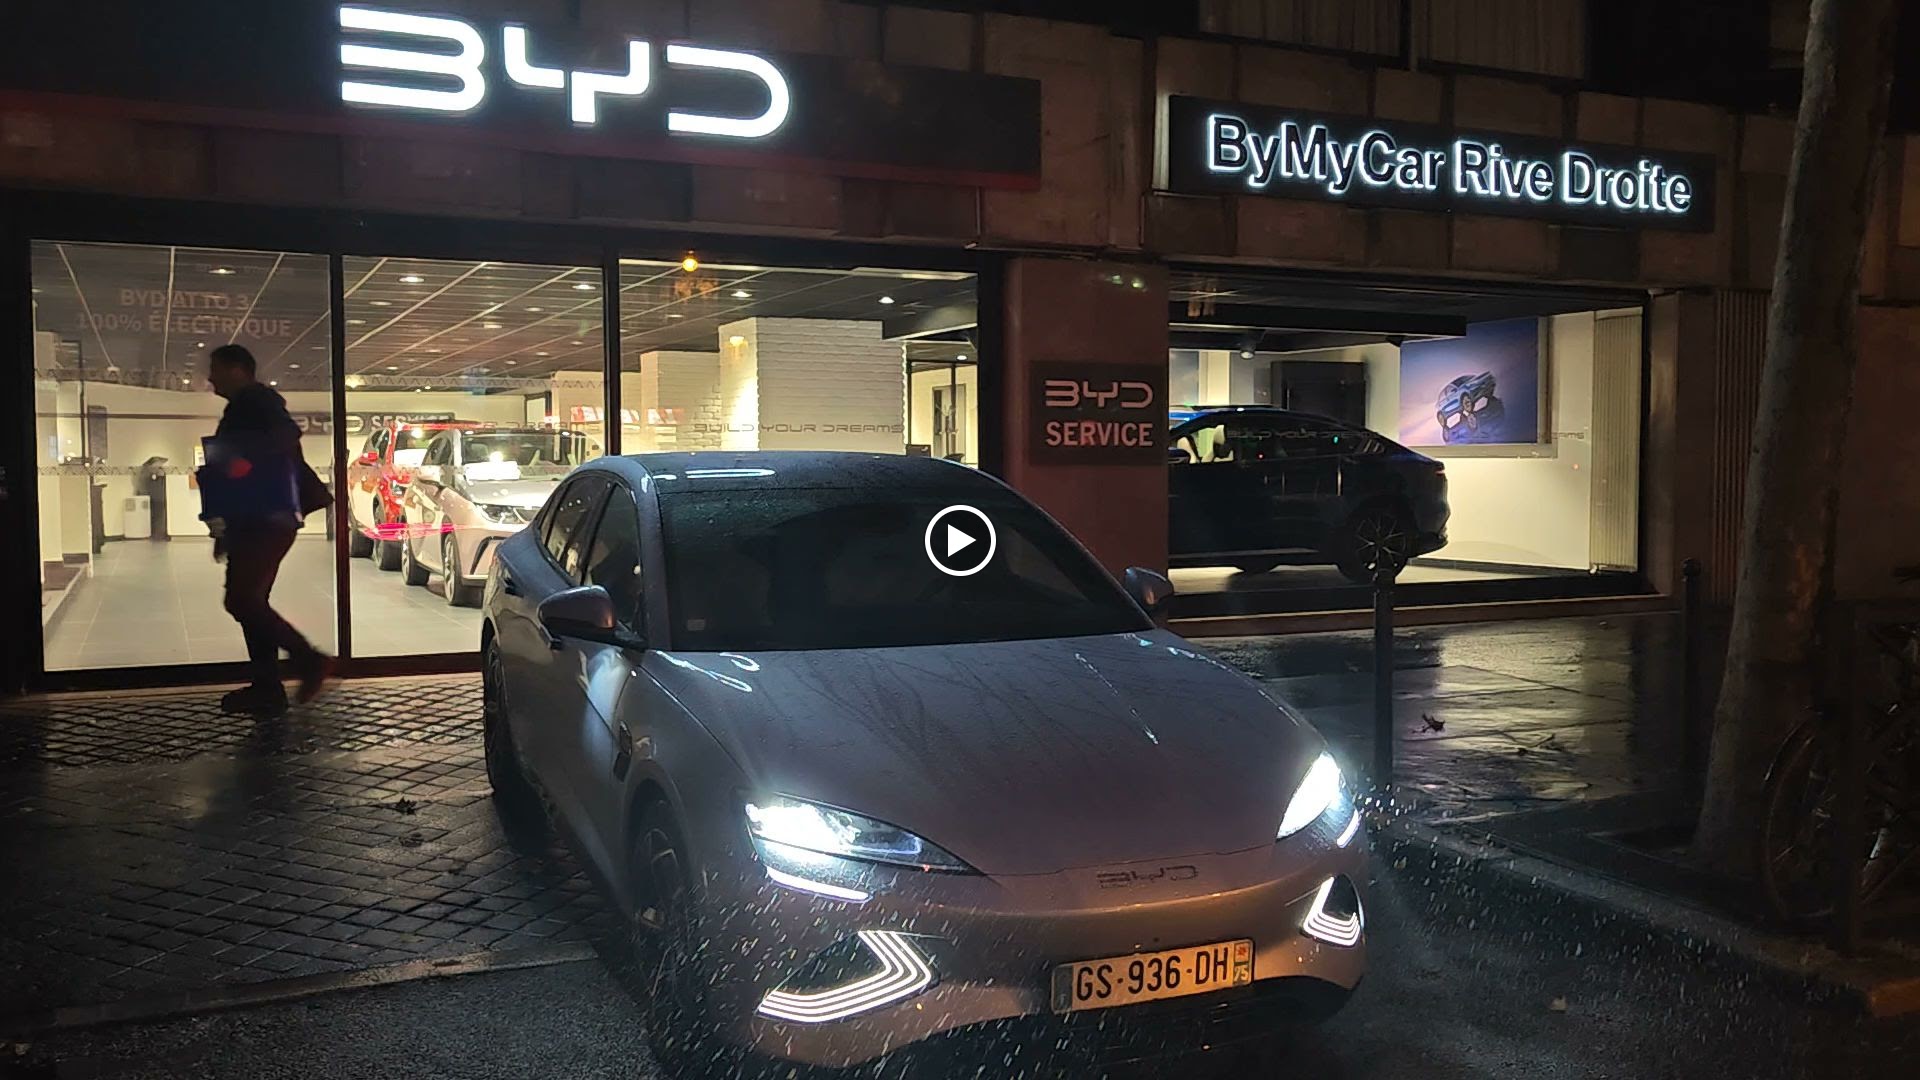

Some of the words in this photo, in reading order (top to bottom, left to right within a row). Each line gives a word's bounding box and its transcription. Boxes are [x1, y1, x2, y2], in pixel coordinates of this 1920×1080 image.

[339, 6, 790, 138] BYD
[1208, 114, 1446, 193] ByMyCar
[1453, 140, 1555, 201] Rive
[1562, 152, 1692, 213] Droite
[119, 288, 166, 308] BYD
[171, 290, 230, 310] ATTO
[236, 293, 252, 310] 3
[77, 314, 142, 333] 100%
[148, 312, 293, 338] ÉLECTRIQUE
[1044, 380, 1154, 408] BYD
[693, 424, 754, 432] BUILD
[761, 424, 816, 432] YOUR
[821, 424, 903, 433] DREAMS
[1046, 421, 1154, 446] SERVICE
